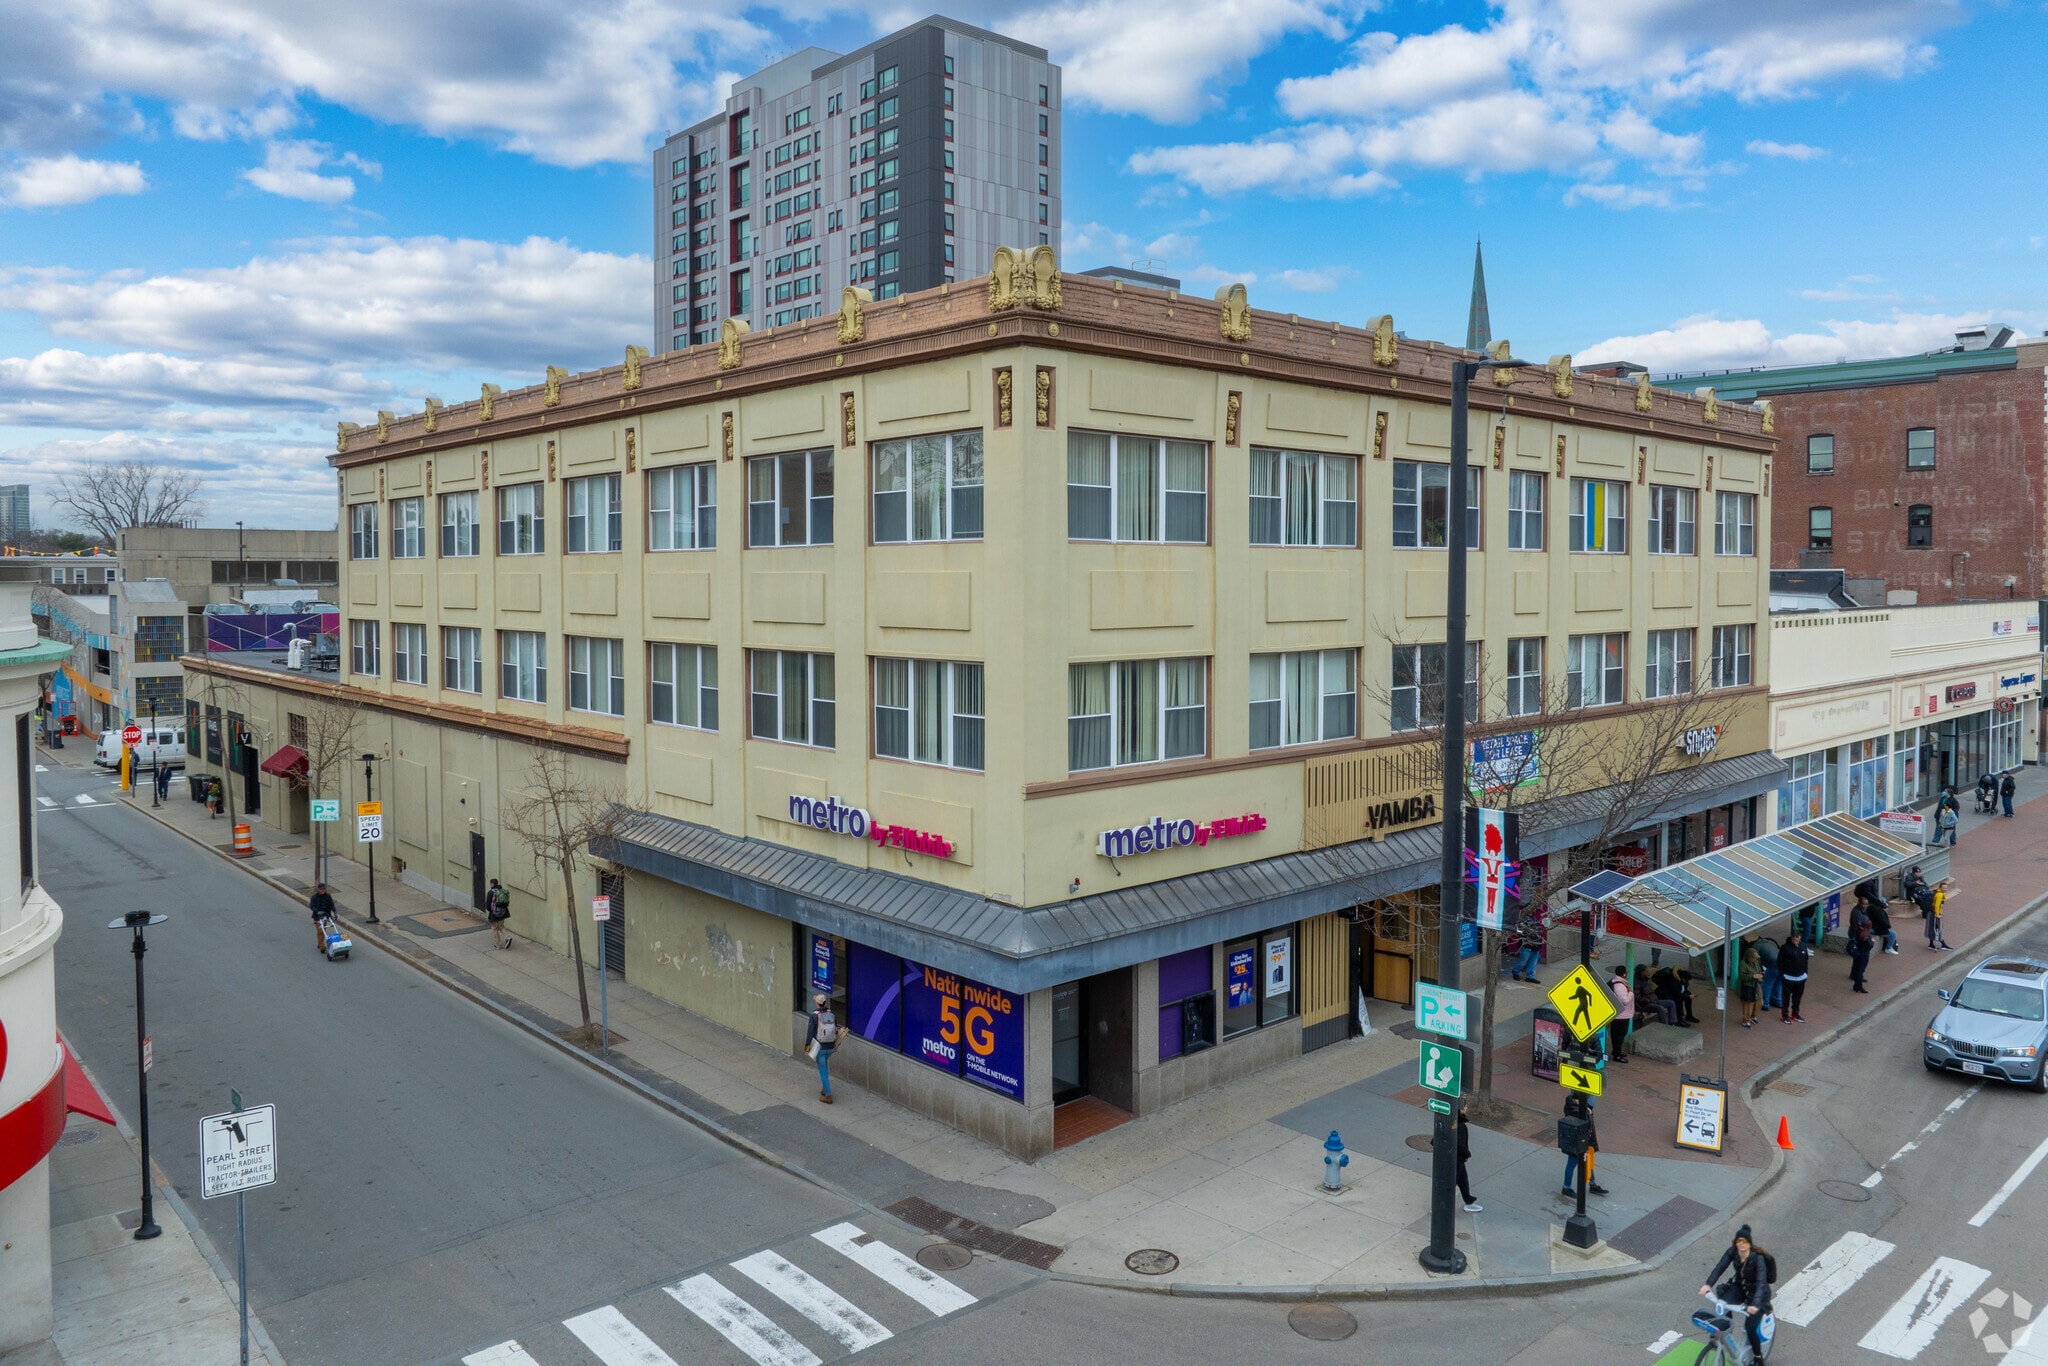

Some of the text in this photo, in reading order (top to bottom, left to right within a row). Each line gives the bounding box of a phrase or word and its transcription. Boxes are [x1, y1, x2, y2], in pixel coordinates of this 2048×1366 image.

[122, 731, 141, 739] STOP
[789, 794, 870, 838] metro
[1368, 794, 1436, 830] YAMBA
[361, 827, 380, 839] 20
[1099, 816, 1196, 858] metro
[1462, 930, 1472, 939] EASE
[940, 995, 995, 1055] 5G
[922, 1037, 955, 1060] metro
[966, 1053, 986, 1066] ON THE
[966, 1060, 991, 1077] T-MOBILE
[990, 1070, 1018, 1087] NETWORK
[206, 1144, 271, 1165] PEARL STREET
[216, 1156, 263, 1172] TIGHT RADIUS
[207, 1164, 272, 1183] TRACTOR-TRAILERS
[211, 1183, 229, 1193] SEEK
[246, 1173, 269, 1183] ROUTE
